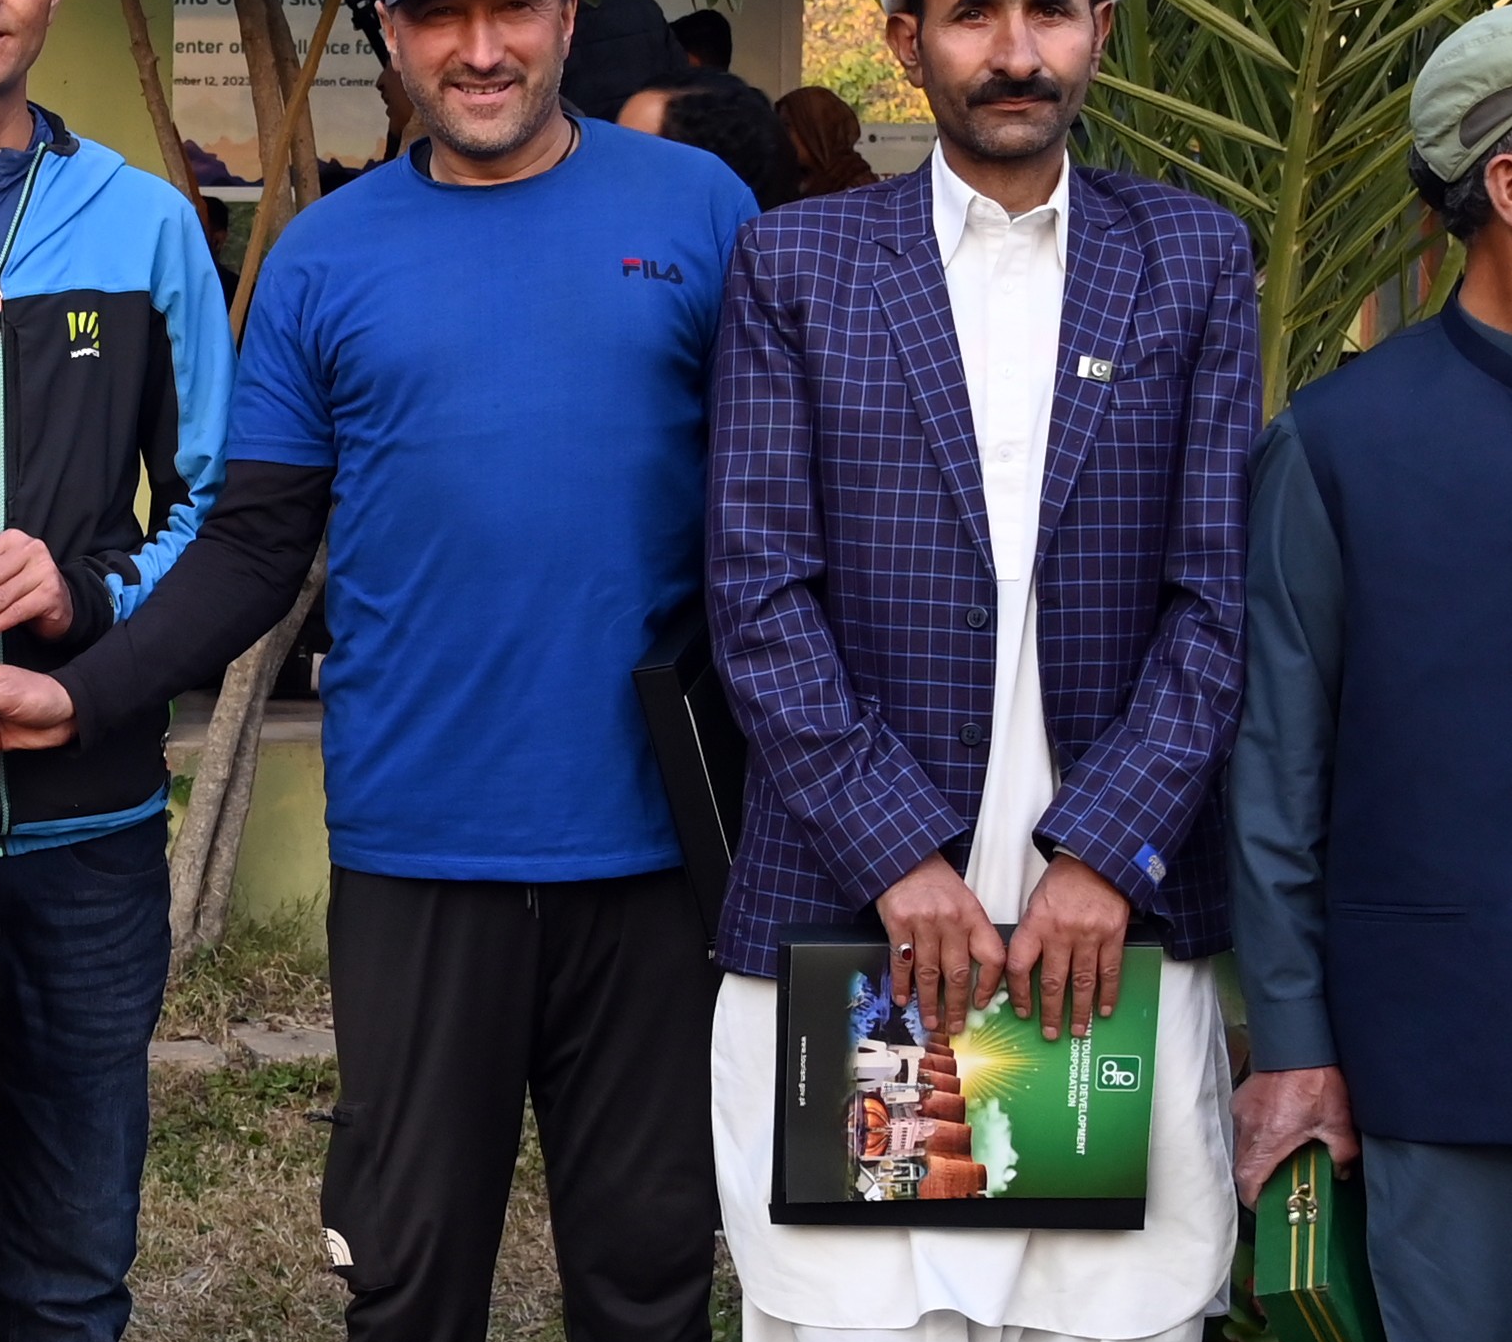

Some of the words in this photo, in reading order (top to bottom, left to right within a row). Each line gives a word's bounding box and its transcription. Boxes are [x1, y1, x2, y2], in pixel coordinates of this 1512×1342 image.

[174, 38, 223, 55] enter
[622, 257, 684, 285] FILA
[1067, 1037, 1080, 1108] CORPORATION
[1081, 1038, 1092, 1083] TOURISM
[1075, 1081, 1089, 1156] DEVELOPMENT
